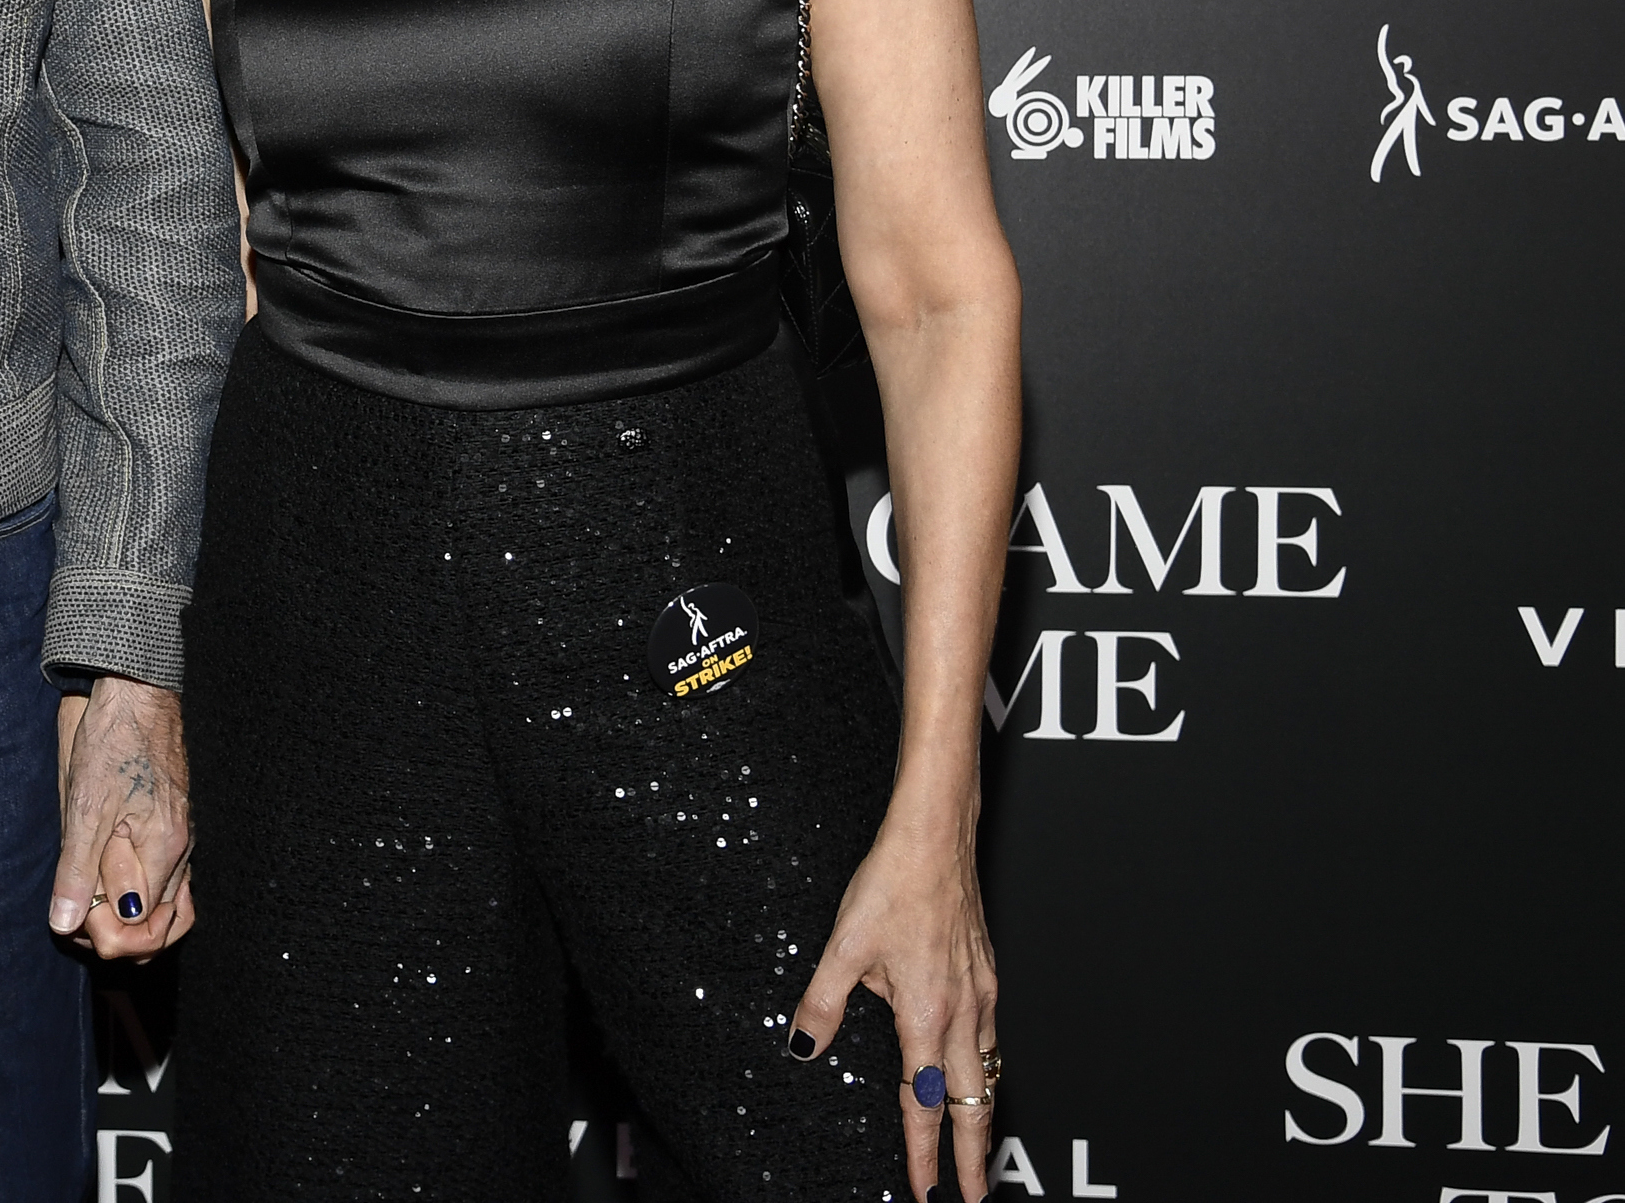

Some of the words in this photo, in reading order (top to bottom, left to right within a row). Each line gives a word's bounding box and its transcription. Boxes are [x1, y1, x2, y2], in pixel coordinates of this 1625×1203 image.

[1076, 75, 1215, 118] KILLER
[1093, 117, 1216, 161] FILMS
[674, 645, 753, 697] STRIKE!
[701, 654, 719, 668] ON
[1284, 1032, 1611, 1155] SHE
